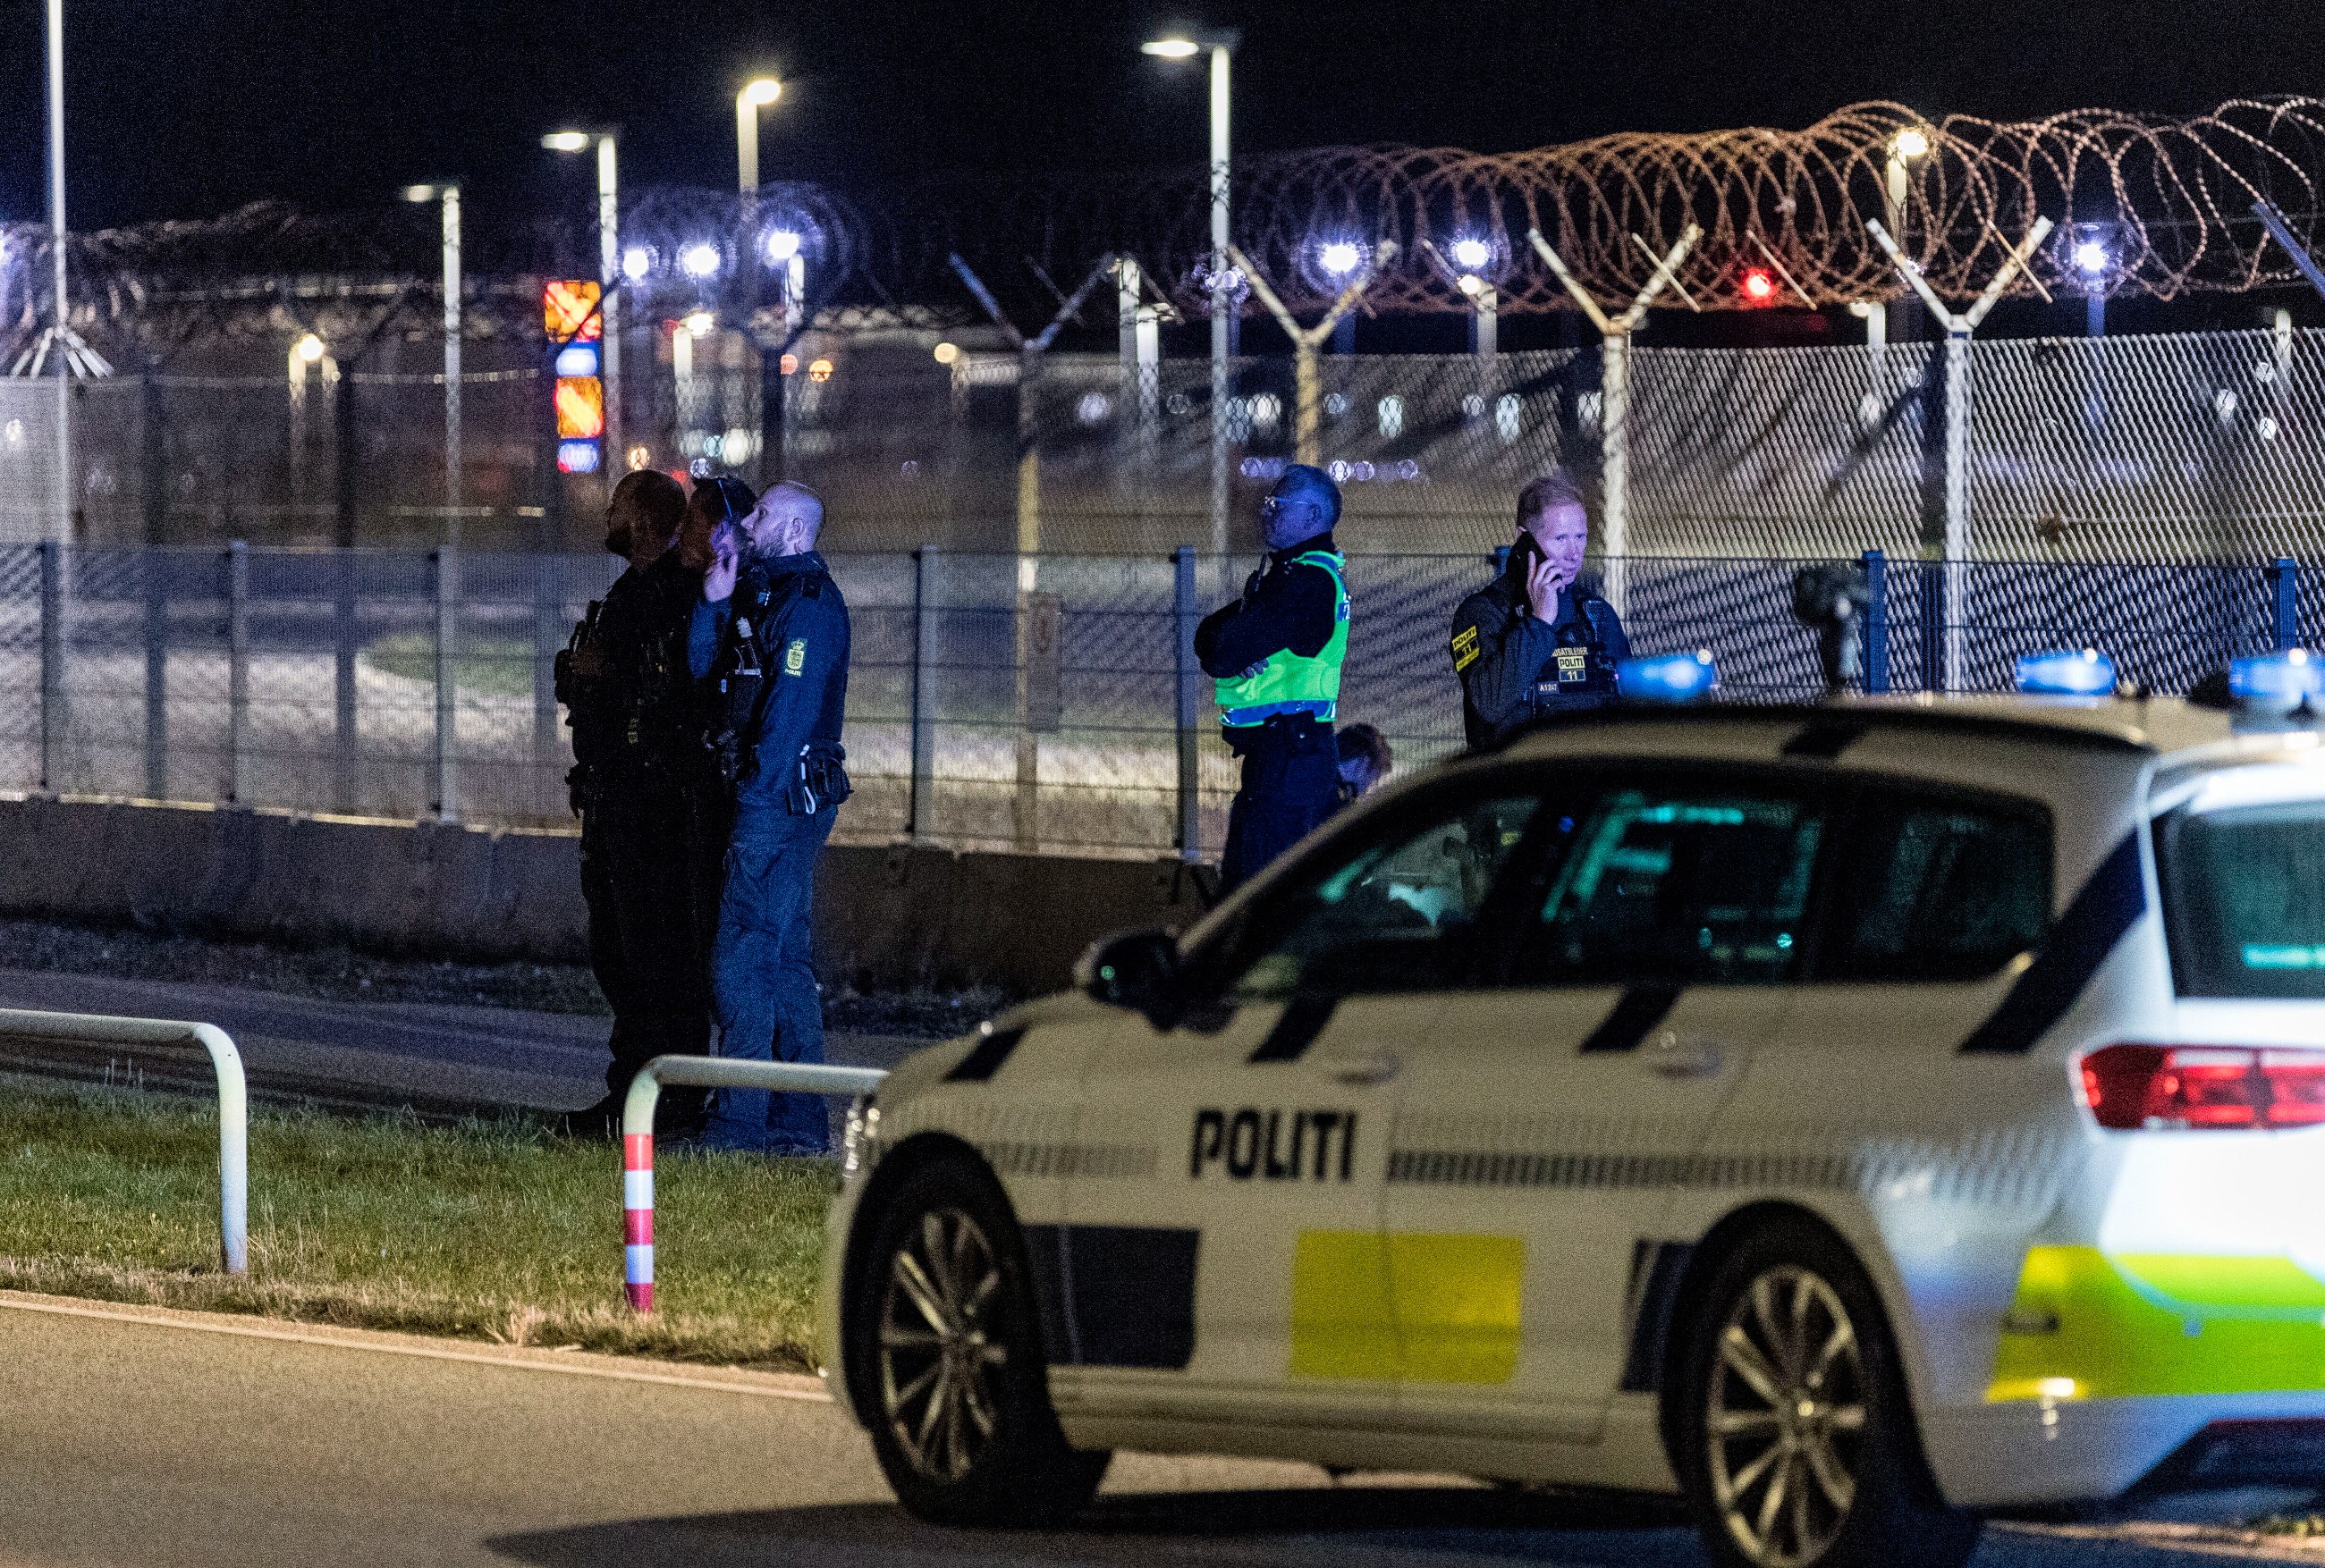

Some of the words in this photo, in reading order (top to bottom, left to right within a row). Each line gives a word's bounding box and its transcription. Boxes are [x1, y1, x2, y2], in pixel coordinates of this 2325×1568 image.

[1454, 628, 1475, 647] POLITI
[1462, 643, 1472, 654] 11
[1559, 658, 1584, 668] POLITI
[1567, 670, 1577, 680] 11
[1191, 1109, 1357, 1181] POLITI
